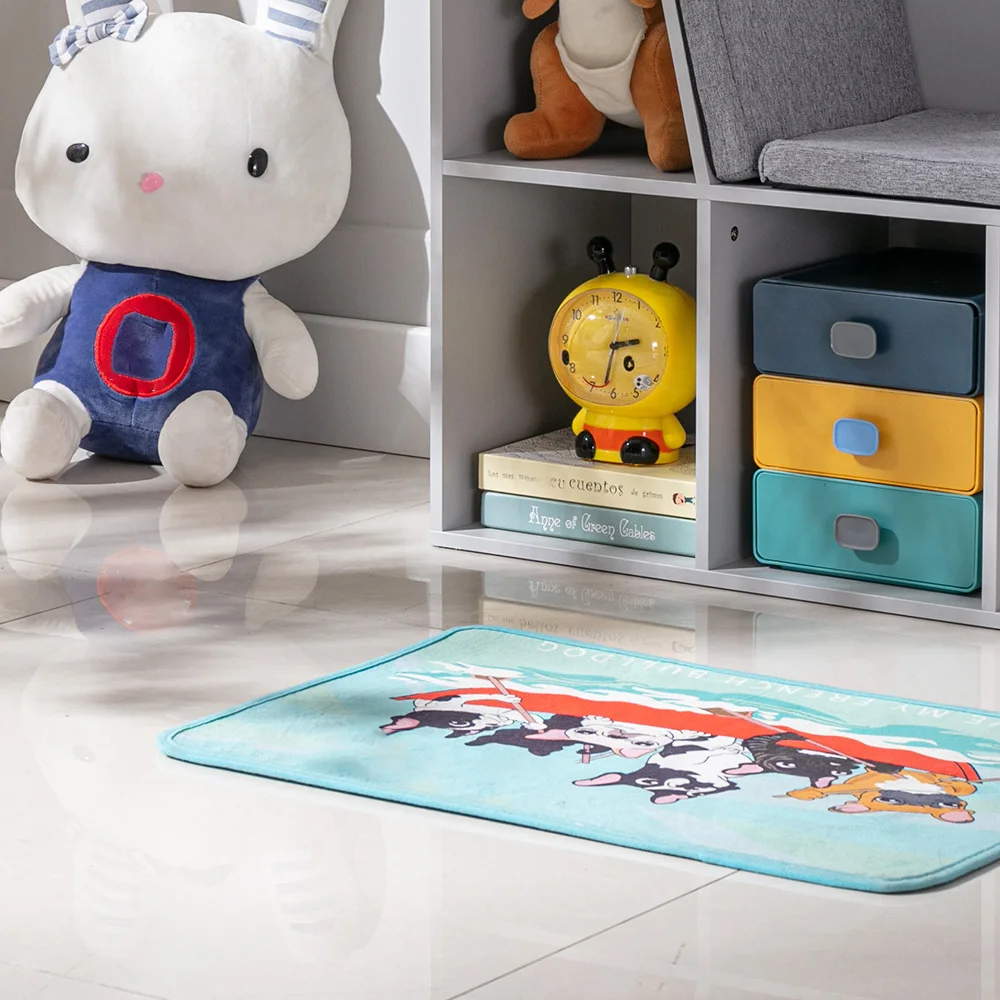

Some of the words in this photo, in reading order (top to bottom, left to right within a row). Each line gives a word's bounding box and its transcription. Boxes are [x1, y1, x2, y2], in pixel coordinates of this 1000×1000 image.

[591, 295, 599, 306] 11
[612, 291, 622, 303] 12
[572, 309, 582, 320] 10
[562, 334, 568, 344] 9
[569, 362, 576, 373] 8
[610, 388, 617, 399] 6
[632, 388, 640, 398] 5
[569, 478, 624, 497] cuentos
[528, 505, 561, 533] Anne
[565, 515, 578, 530] of
[581, 512, 615, 540] Green
[619, 517, 656, 541] Gables
[537, 640, 709, 680] BULLDOG
[723, 672, 876, 708] FRENCH
[891, 699, 950, 720] MY
